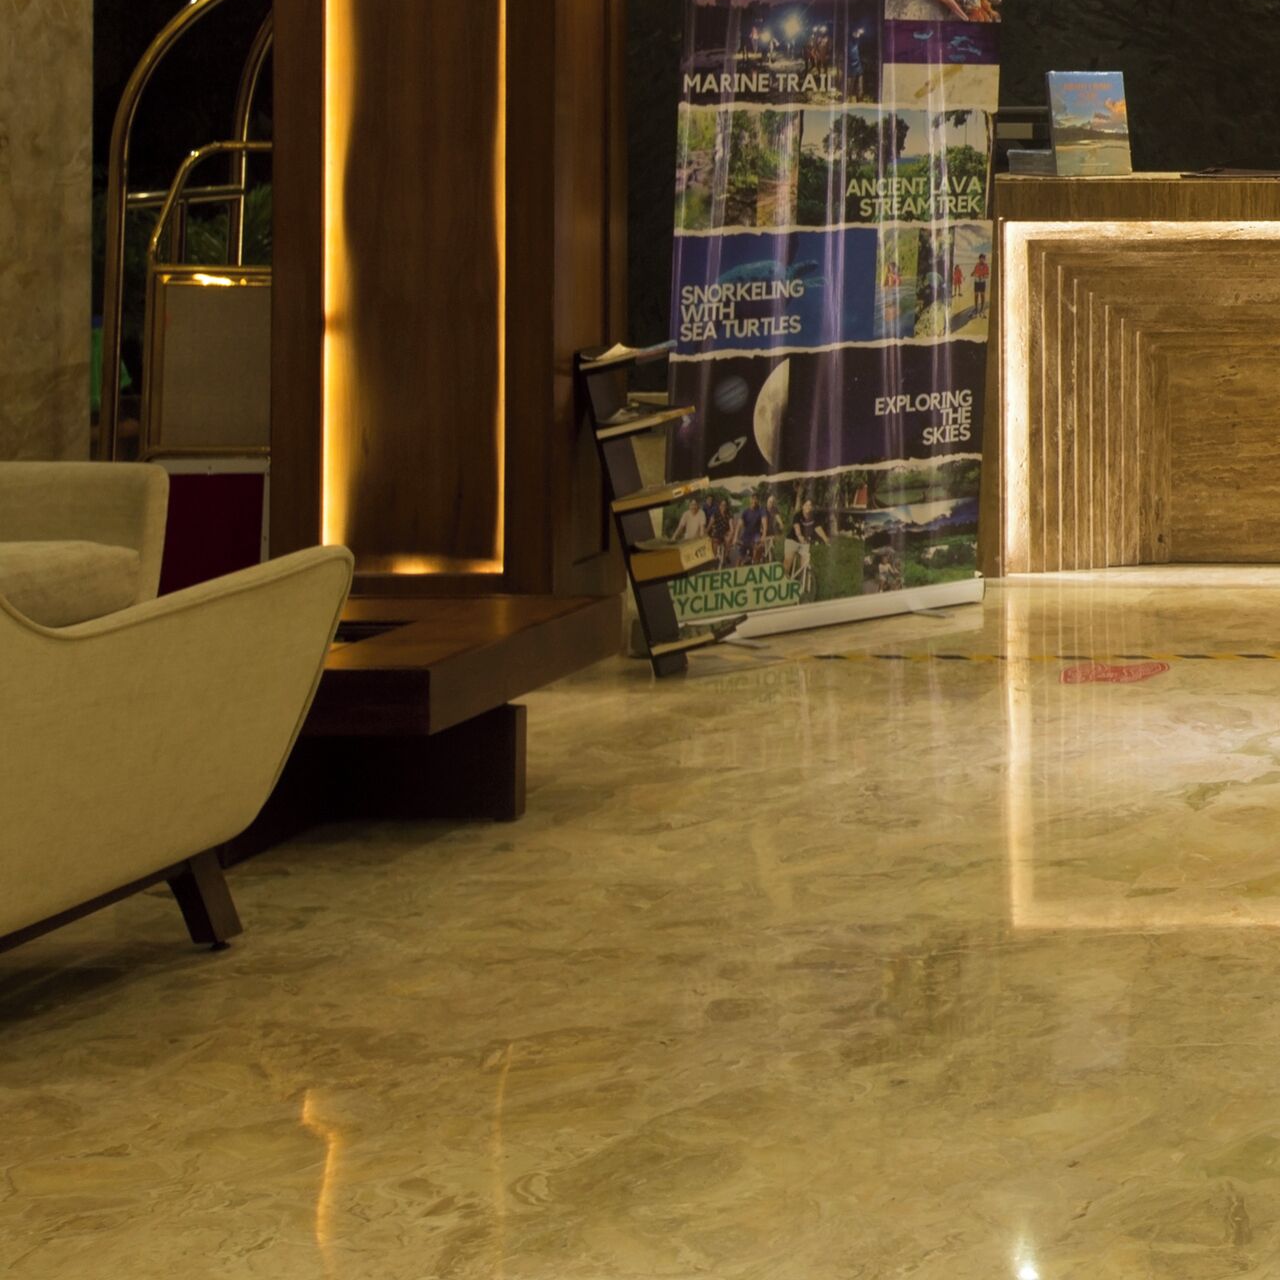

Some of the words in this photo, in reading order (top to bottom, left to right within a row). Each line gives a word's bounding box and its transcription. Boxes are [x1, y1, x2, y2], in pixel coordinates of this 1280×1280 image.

[683, 73, 770, 93] MARINE
[775, 72, 836, 93] TRAIL
[845, 176, 927, 197] ANCIENT
[930, 175, 982, 195] LAVA
[860, 197, 935, 217] STREAM
[937, 195, 981, 213] TREK
[681, 279, 804, 305] SNORKELING
[681, 302, 735, 324] WITH
[680, 321, 718, 342] SEA
[722, 315, 802, 339] TURTLES
[874, 389, 973, 416] EXPLORING
[940, 406, 972, 426] THE
[922, 423, 971, 446] SKIES
[676, 589, 748, 616] YCLING
[752, 582, 800, 605] TOUR
